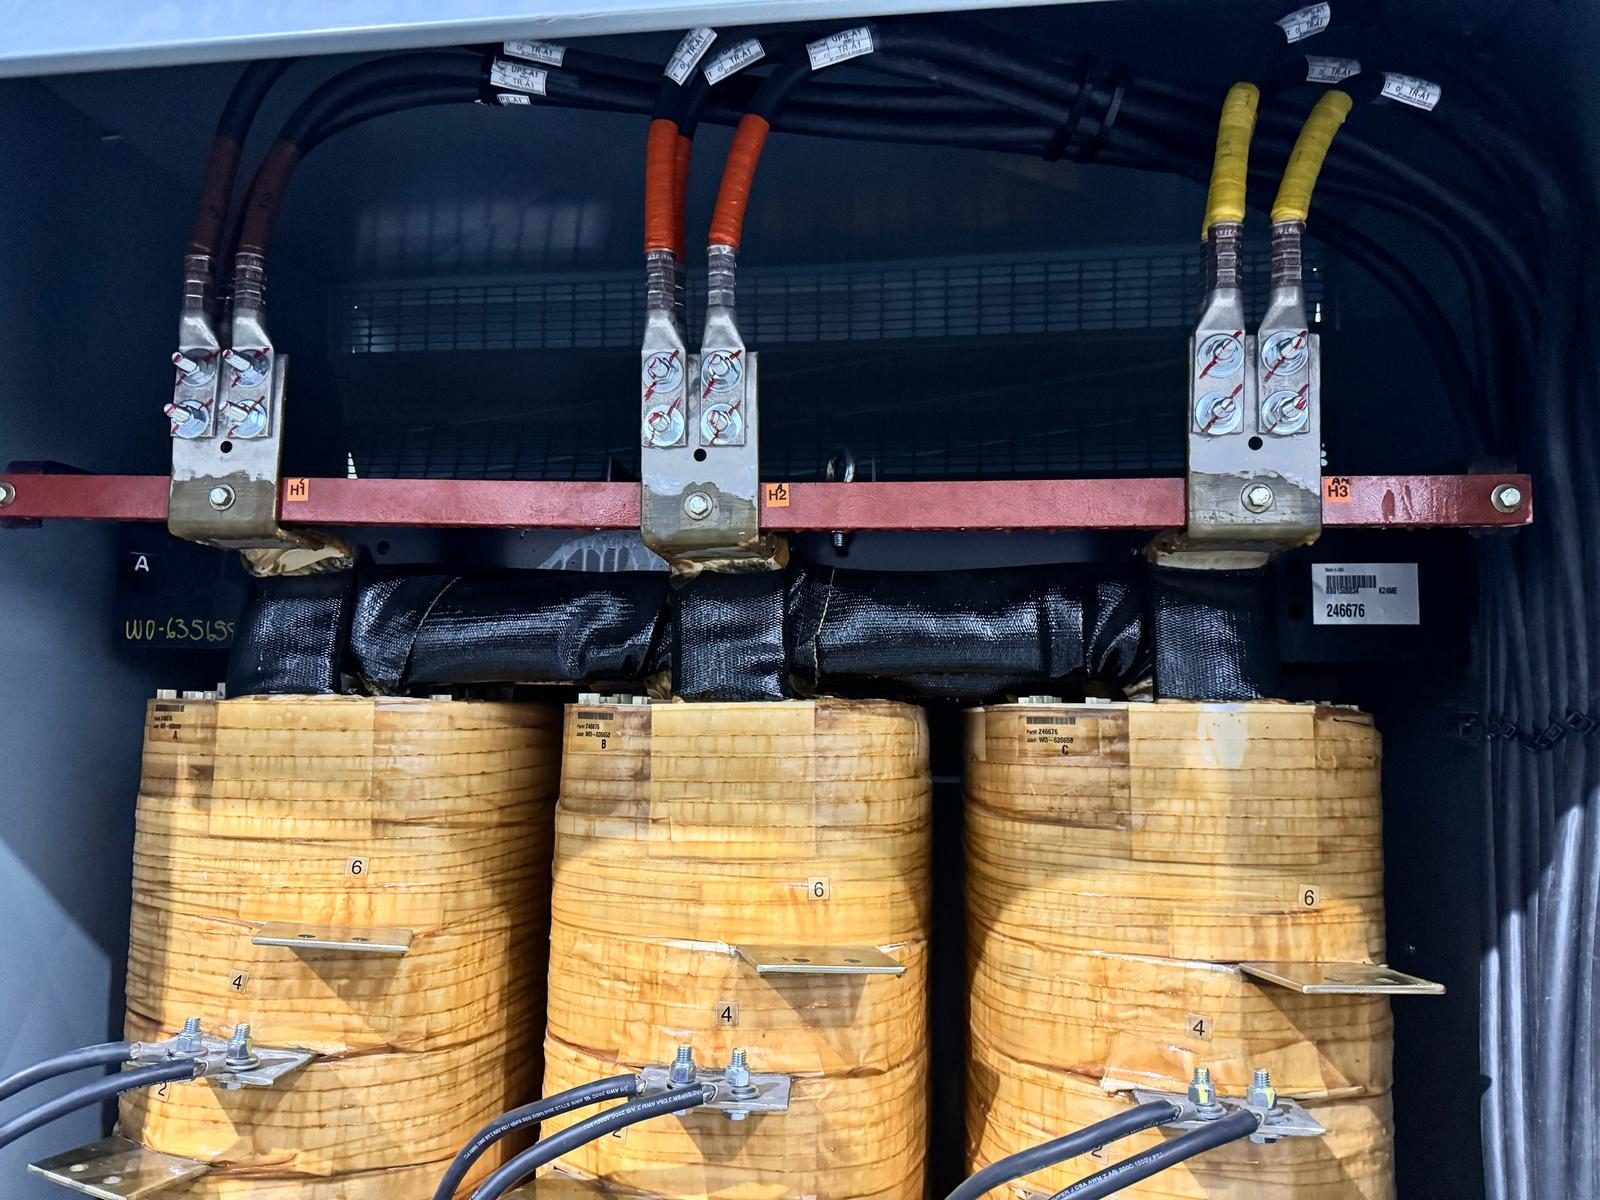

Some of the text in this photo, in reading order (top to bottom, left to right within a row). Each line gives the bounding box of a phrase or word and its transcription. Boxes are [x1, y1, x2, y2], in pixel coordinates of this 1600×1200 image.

[682, 35, 704, 56] TR-A1
[730, 48, 752, 65] TR-A1
[1408, 87, 1430, 101] TR-A1
[769, 490, 787, 500] H2
[1328, 486, 1348, 497] H3
[134, 556, 150, 572] A
[1326, 604, 1365, 618] 246676
[172, 730, 178, 740] A
[602, 739, 606, 748] B
[1062, 745, 1068, 755] C
[351, 860, 362, 875] 6
[814, 882, 824, 898] 6
[1304, 890, 1314, 906] 6
[232, 974, 243, 990] 4
[720, 1006, 732, 1022] 4
[1192, 1020, 1205, 1036] 4
[1073, 1181, 1087, 1190] CSA
[1087, 1175, 1102, 1185] AWM
[1118, 1163, 1134, 1173] 200C
